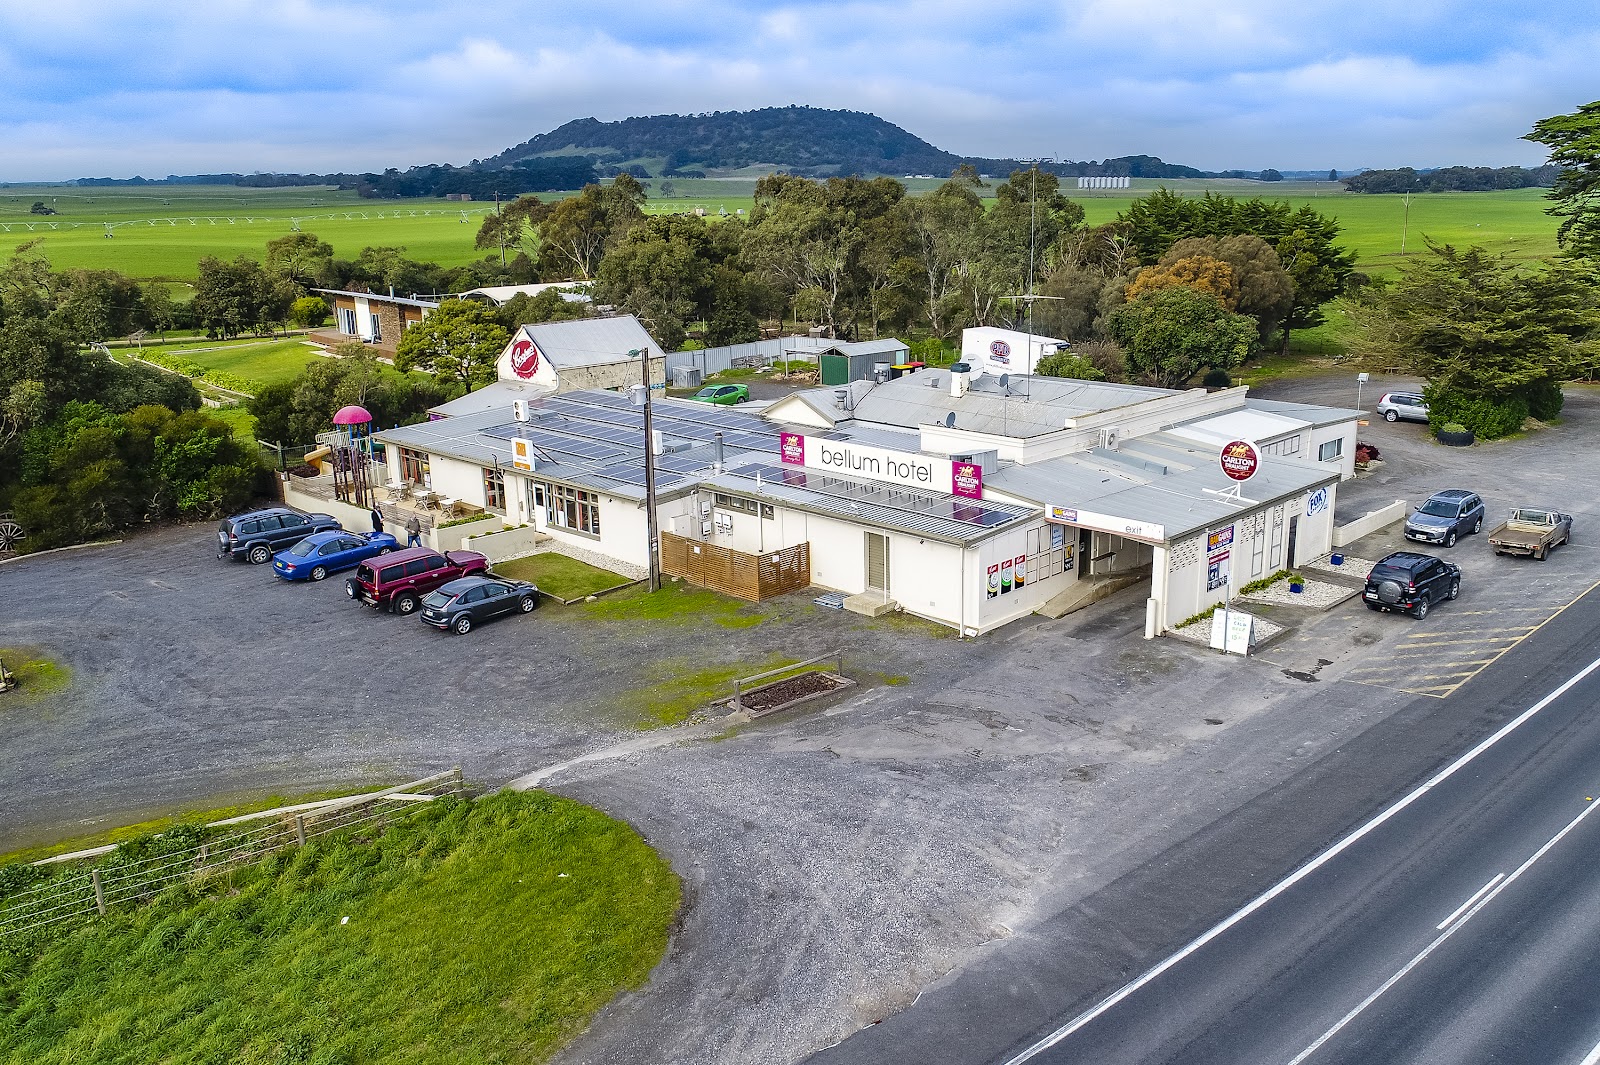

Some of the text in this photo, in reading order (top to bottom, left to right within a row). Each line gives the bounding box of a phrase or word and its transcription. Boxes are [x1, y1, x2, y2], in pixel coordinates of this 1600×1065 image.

[821, 445, 932, 483] bellum hotel
[1222, 455, 1254, 466] CARLTON
[954, 475, 979, 486] CARLTON
[1310, 490, 1323, 510] FOX
[1125, 525, 1142, 535] exit
